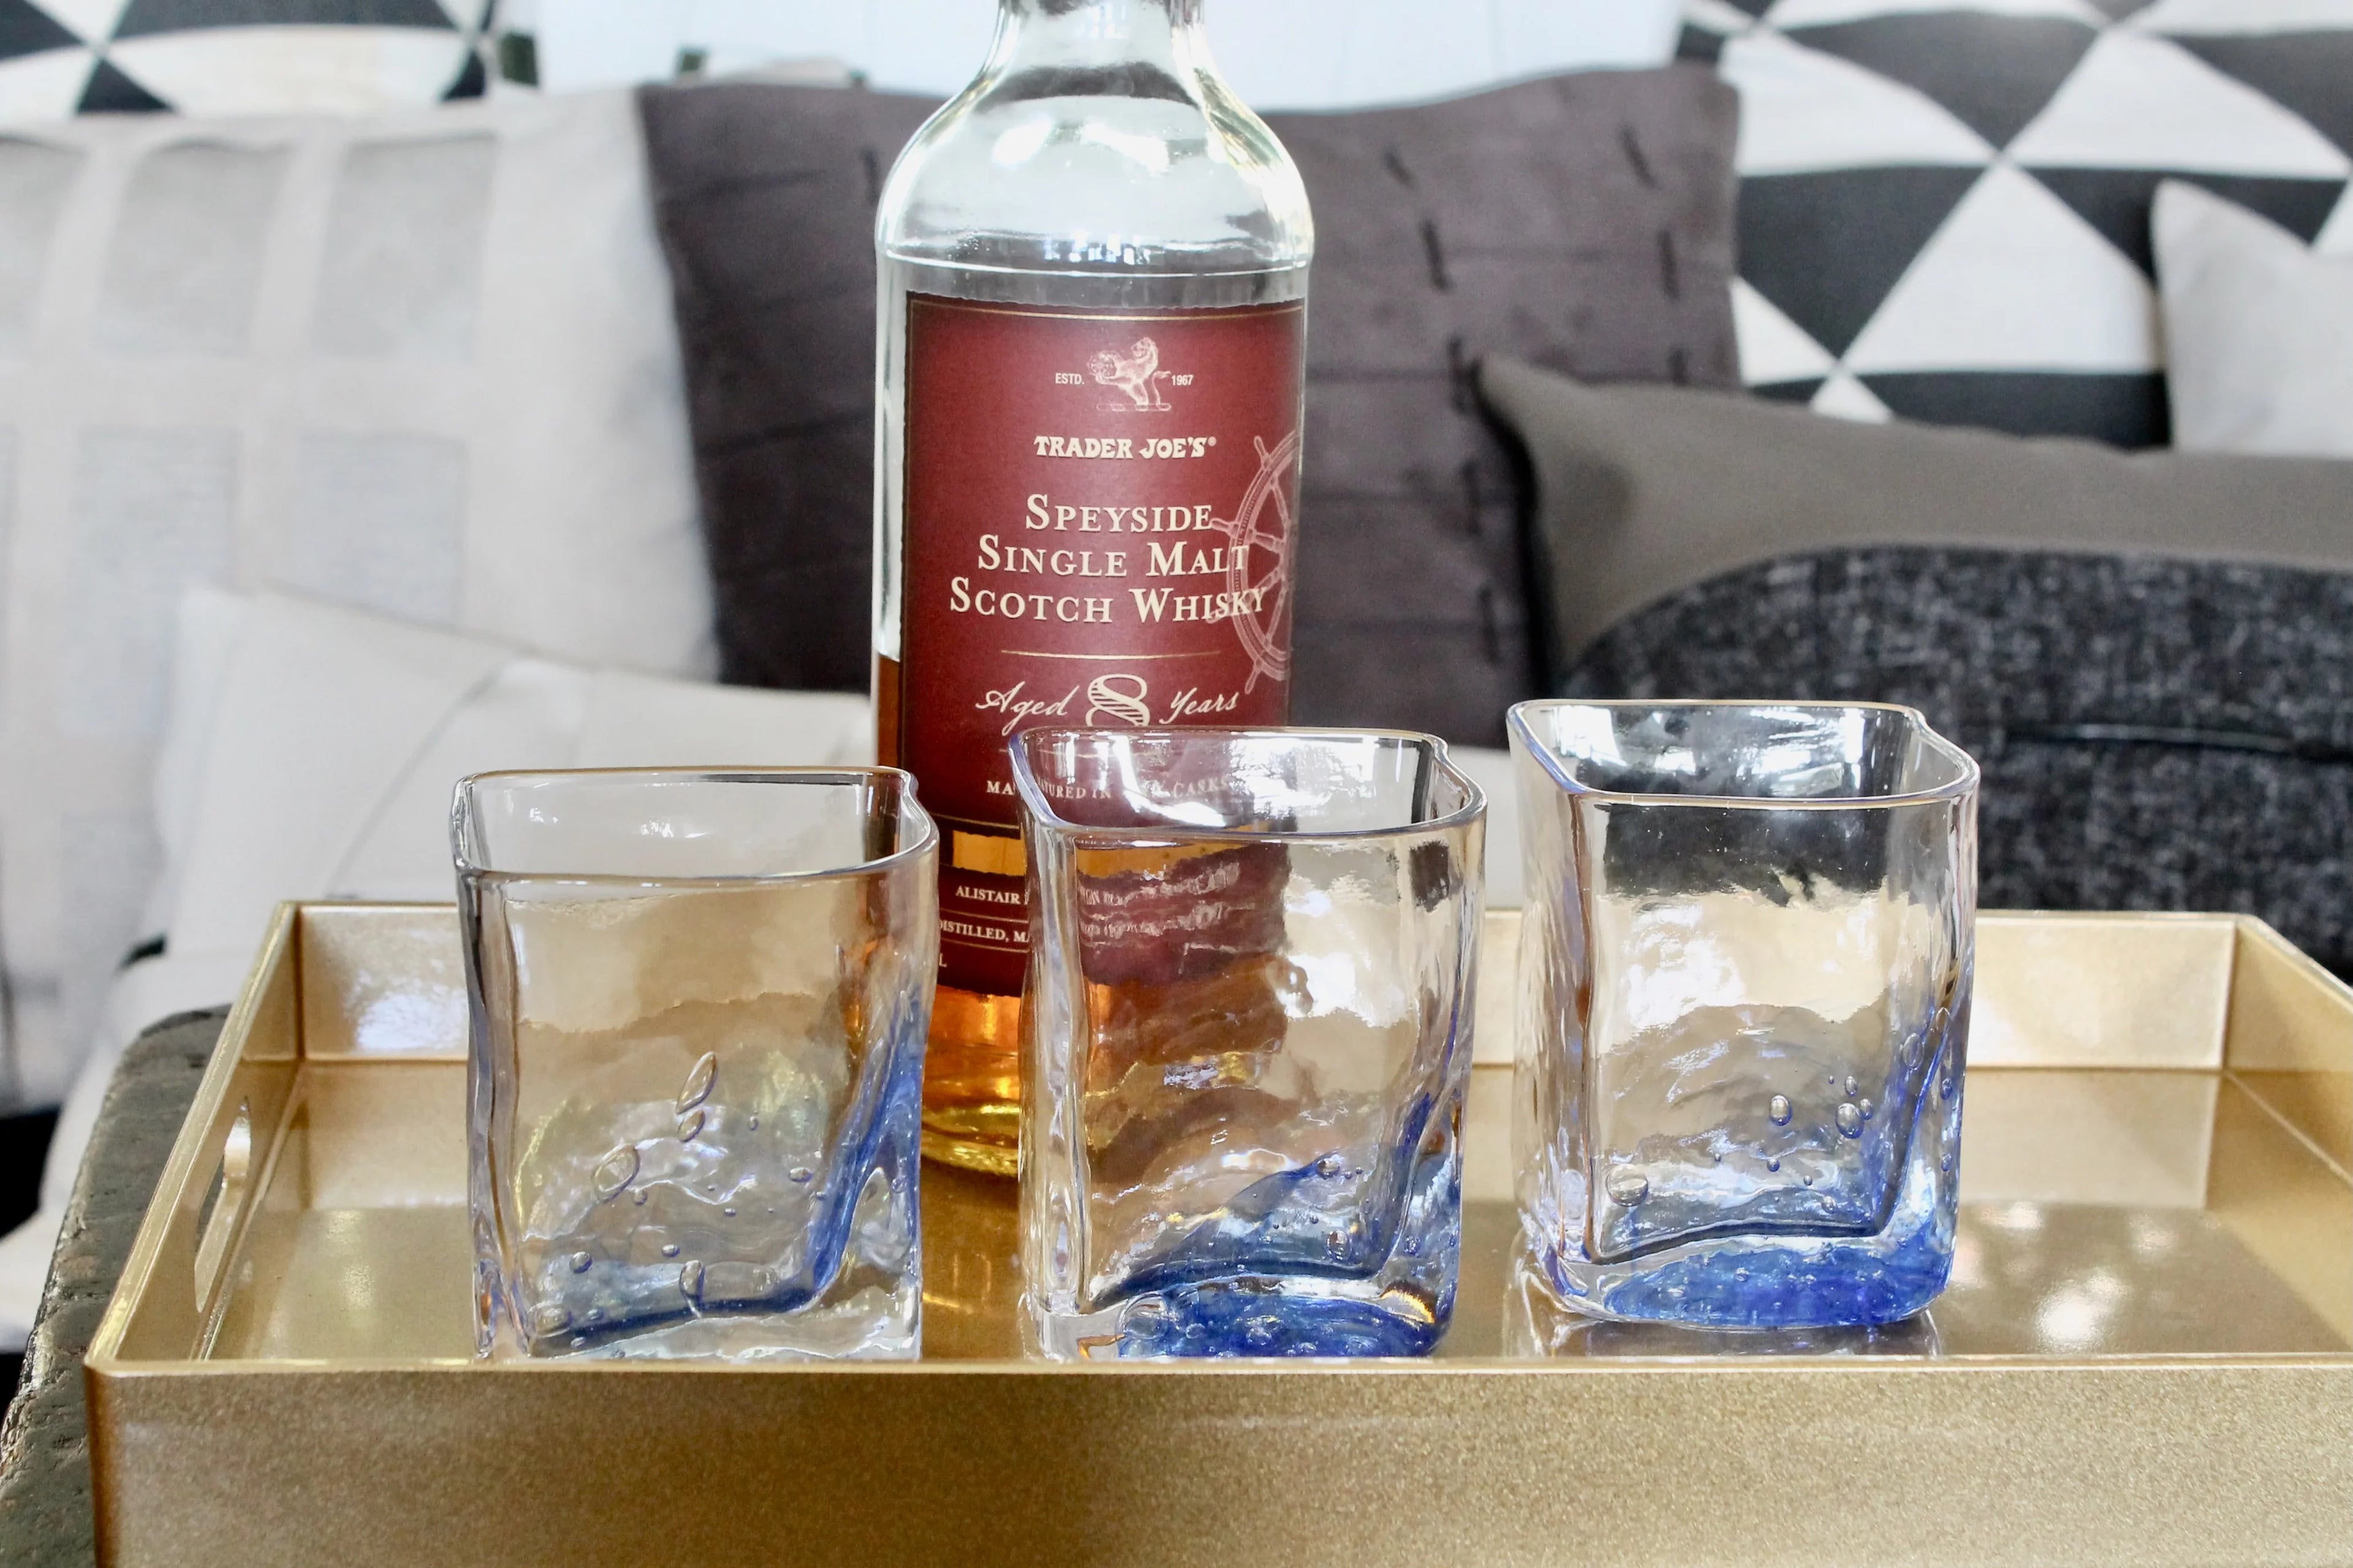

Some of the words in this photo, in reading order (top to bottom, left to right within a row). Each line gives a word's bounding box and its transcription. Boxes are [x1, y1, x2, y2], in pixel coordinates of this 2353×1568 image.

[1055, 373, 1085, 385] ESTD.
[1171, 374, 1194, 385] 1967
[1034, 436, 1134, 460] TRADER
[1025, 494, 1212, 533] SPEYSIDE
[978, 534, 1127, 577] SINGLE
[1145, 540, 1250, 577] MALT
[950, 576, 1113, 623] SCOTCH
[1128, 586, 1267, 623] WHISKY
[976, 681, 1080, 736] Aged
[1085, 673, 1150, 727] 8
[1159, 687, 1240, 725] Years
[955, 885, 1021, 905] ALISTAIR
